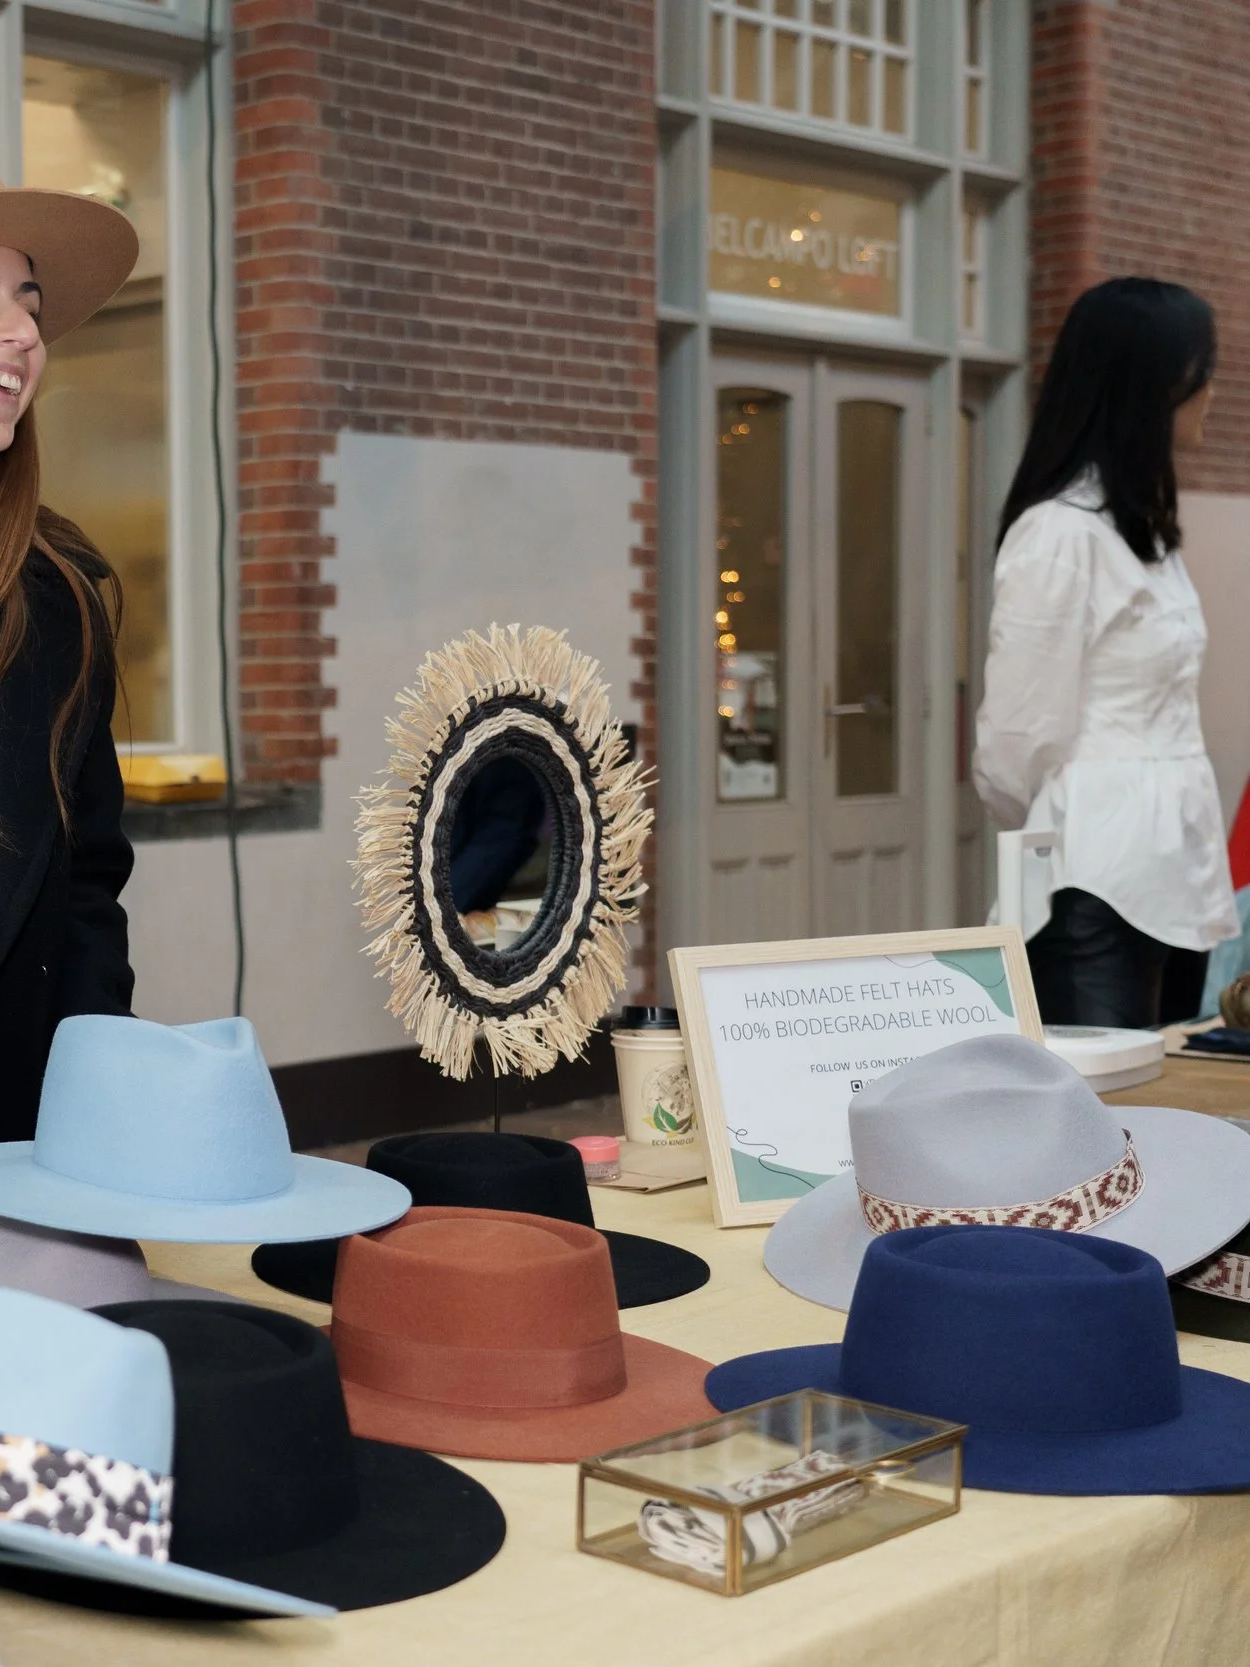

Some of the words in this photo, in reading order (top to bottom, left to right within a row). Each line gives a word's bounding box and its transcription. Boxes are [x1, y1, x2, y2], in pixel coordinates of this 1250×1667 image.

[744, 984, 854, 1010] HANDMADE
[859, 981, 901, 1001] FELT
[906, 977, 955, 998] HATS
[718, 1022, 771, 1042] 100%
[775, 1009, 933, 1039] BIODEGRADABLE
[937, 1004, 998, 1026] WOOL
[810, 1061, 851, 1073] FOLLOW
[855, 1059, 869, 1071] US
[870, 1058, 886, 1069] ON
[651, 1138, 668, 1147] ECO
[668, 1137, 685, 1147] KIND
